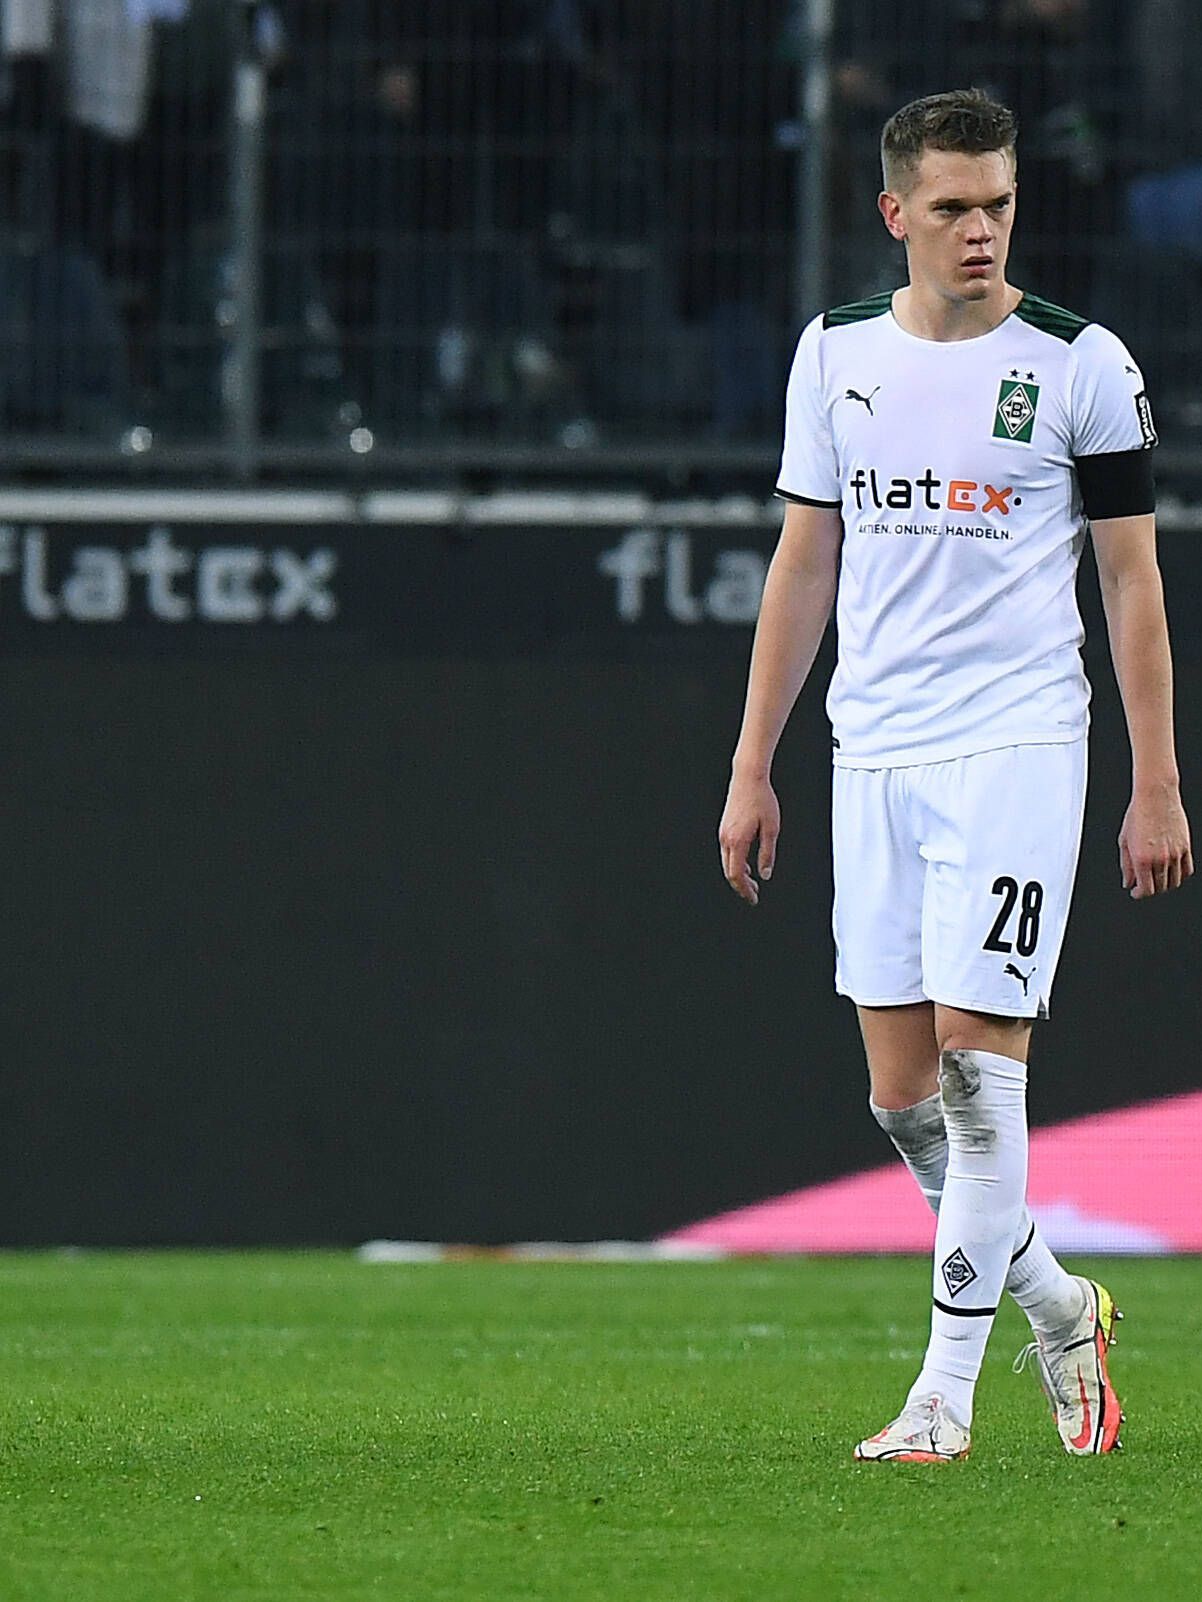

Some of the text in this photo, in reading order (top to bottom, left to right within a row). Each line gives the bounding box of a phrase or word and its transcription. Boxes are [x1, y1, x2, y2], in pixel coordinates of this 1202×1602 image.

[894, 523, 942, 537] ONLINE.
[945, 525, 1014, 540] HANDELN.
[982, 876, 1044, 957] 28
